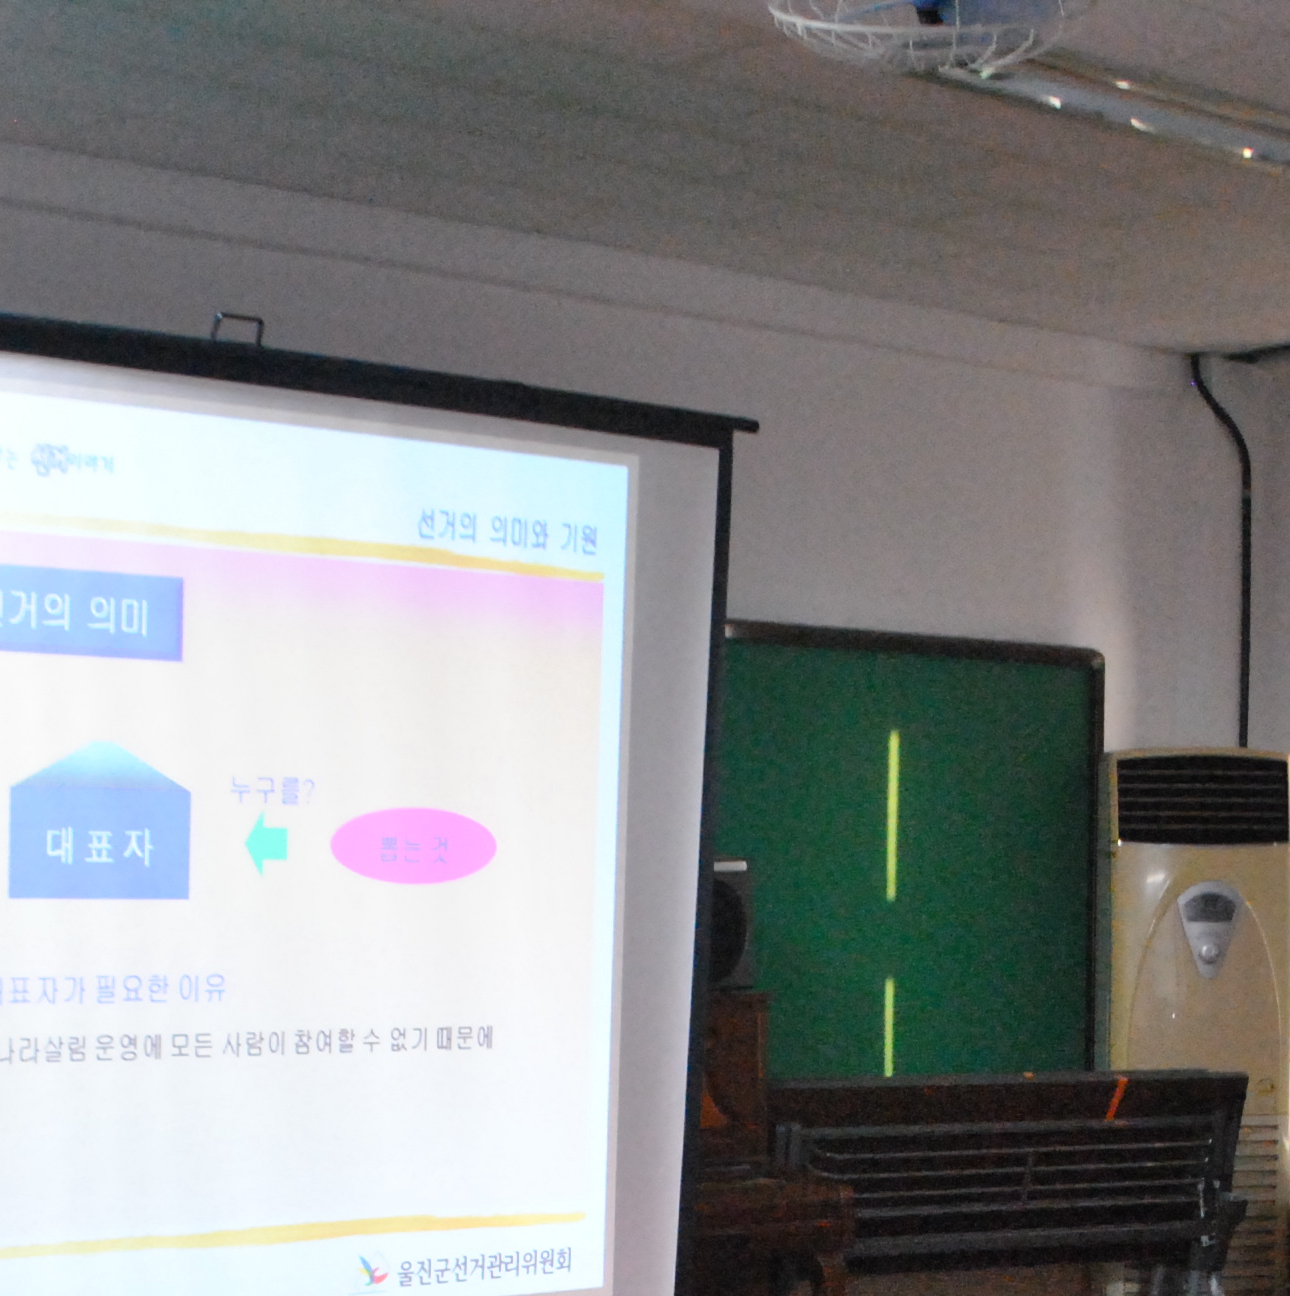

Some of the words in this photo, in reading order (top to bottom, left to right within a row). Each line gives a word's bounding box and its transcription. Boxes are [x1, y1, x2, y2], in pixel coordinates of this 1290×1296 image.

[418, 508, 477, 543] 선거의
[490, 516, 549, 550] 의미와
[561, 523, 598, 555] 기원
[87, 596, 149, 637] 의미
[230, 775, 315, 805] 누구를?
[46, 826, 153, 867] 대표자
[380, 836, 422, 863] 뽑는
[431, 836, 448, 864] 것
[96, 974, 169, 1005] 필요한
[178, 973, 226, 1002] 이유
[95, 1033, 162, 1062] 운영에
[171, 1032, 213, 1059] 모든
[222, 1031, 286, 1057] 사람이
[294, 1028, 356, 1055] 참여할
[362, 1028, 381, 1053] 수
[390, 1026, 428, 1052] 없기
[436, 1025, 494, 1050] 때문에
[397, 1247, 572, 1287] 울진군선거관리위원회
